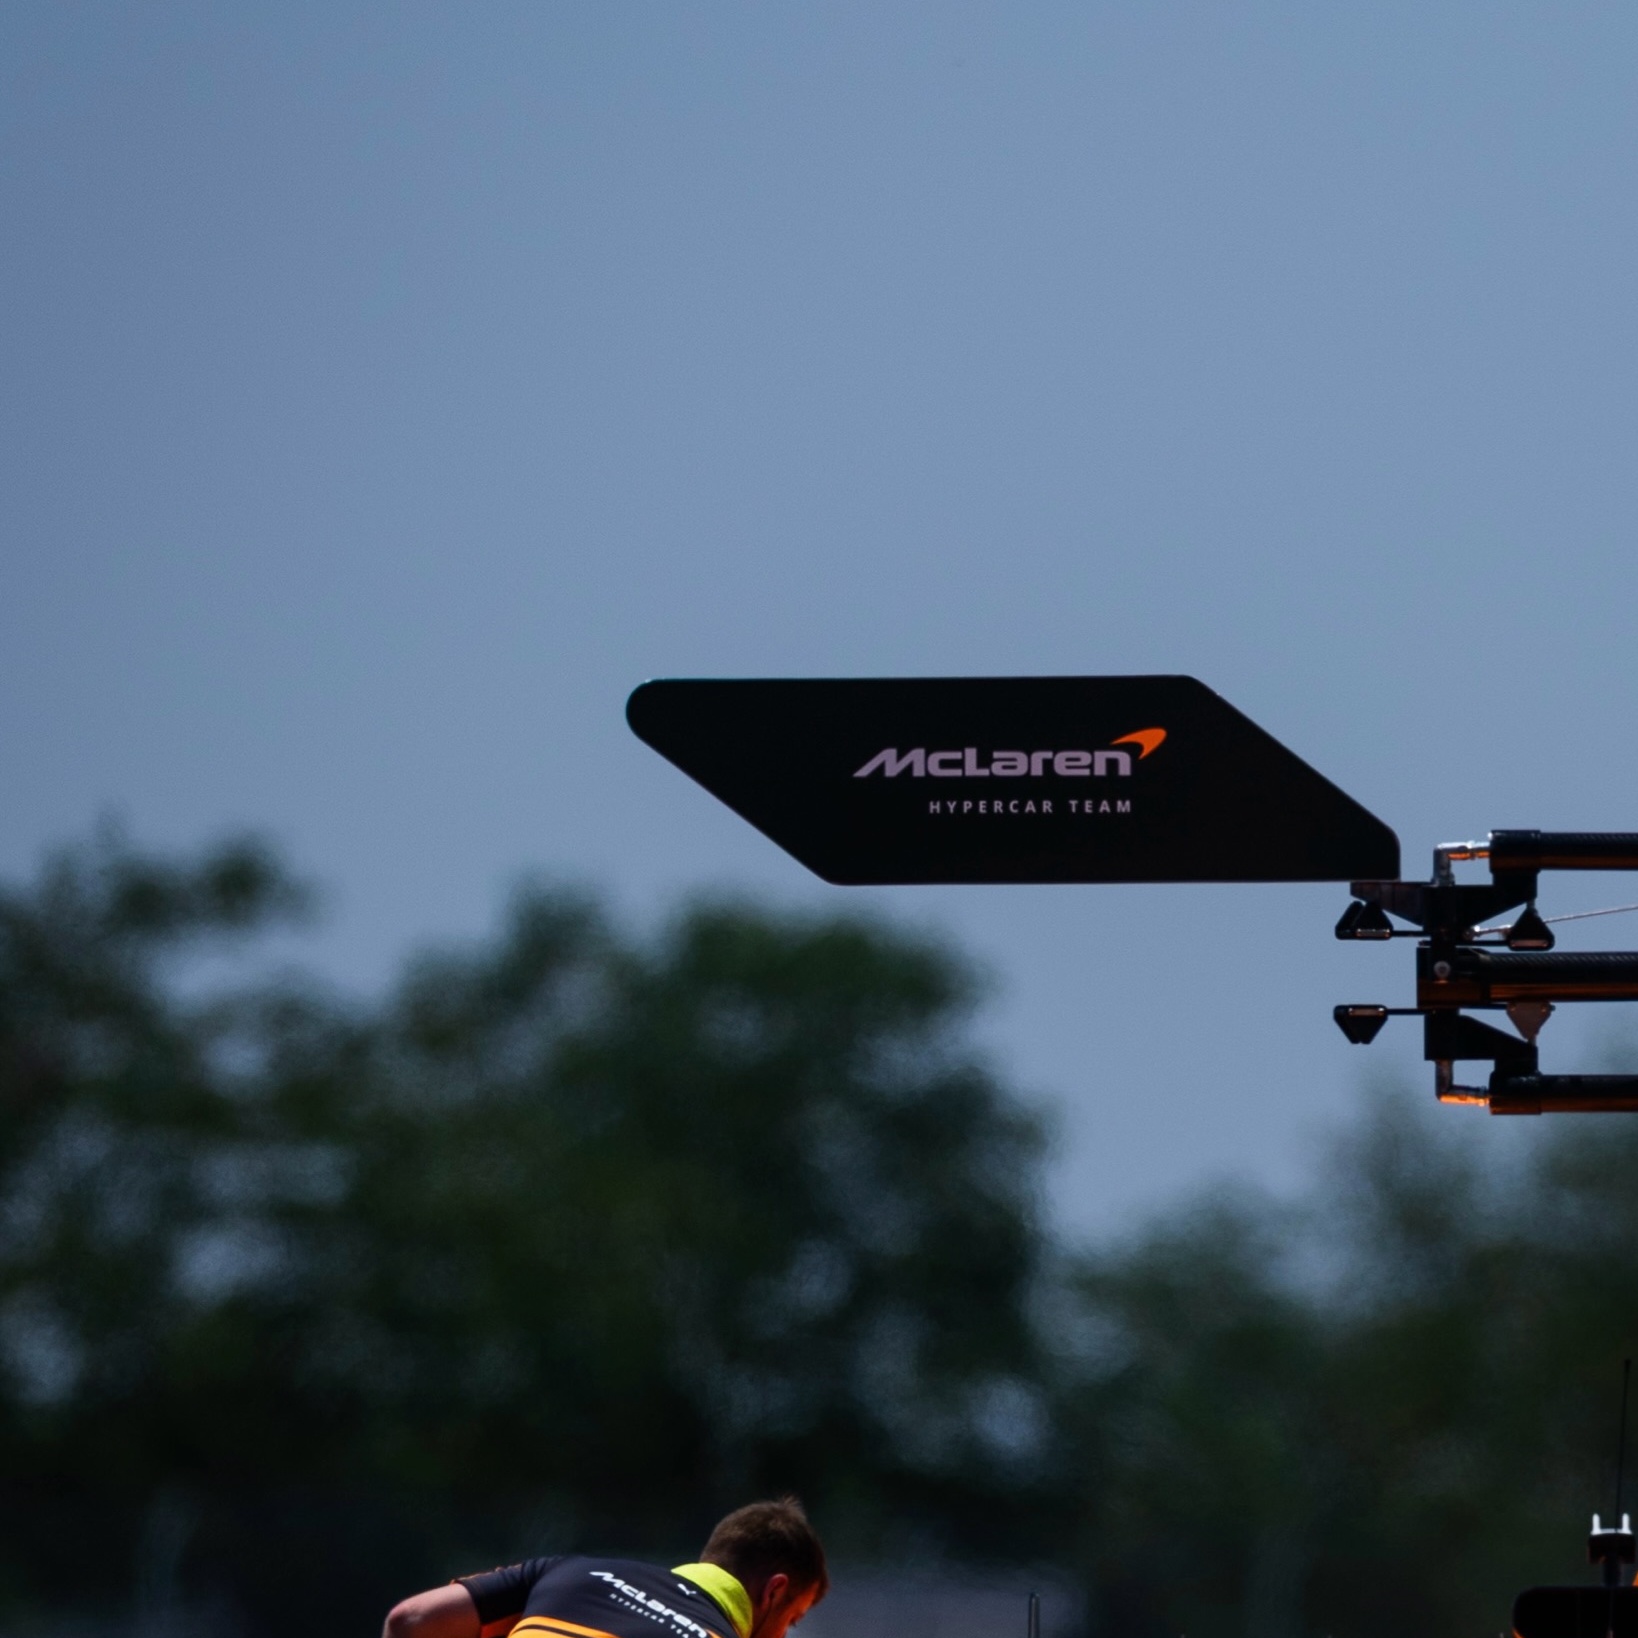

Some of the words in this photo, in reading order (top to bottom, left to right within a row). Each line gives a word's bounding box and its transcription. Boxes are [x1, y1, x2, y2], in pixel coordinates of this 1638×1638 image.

[852, 747, 1132, 777] McLaren
[929, 800, 1053, 814] HYPERCAR
[1069, 800, 1132, 813] TEAM
[589, 1571, 708, 1638] McLaren
